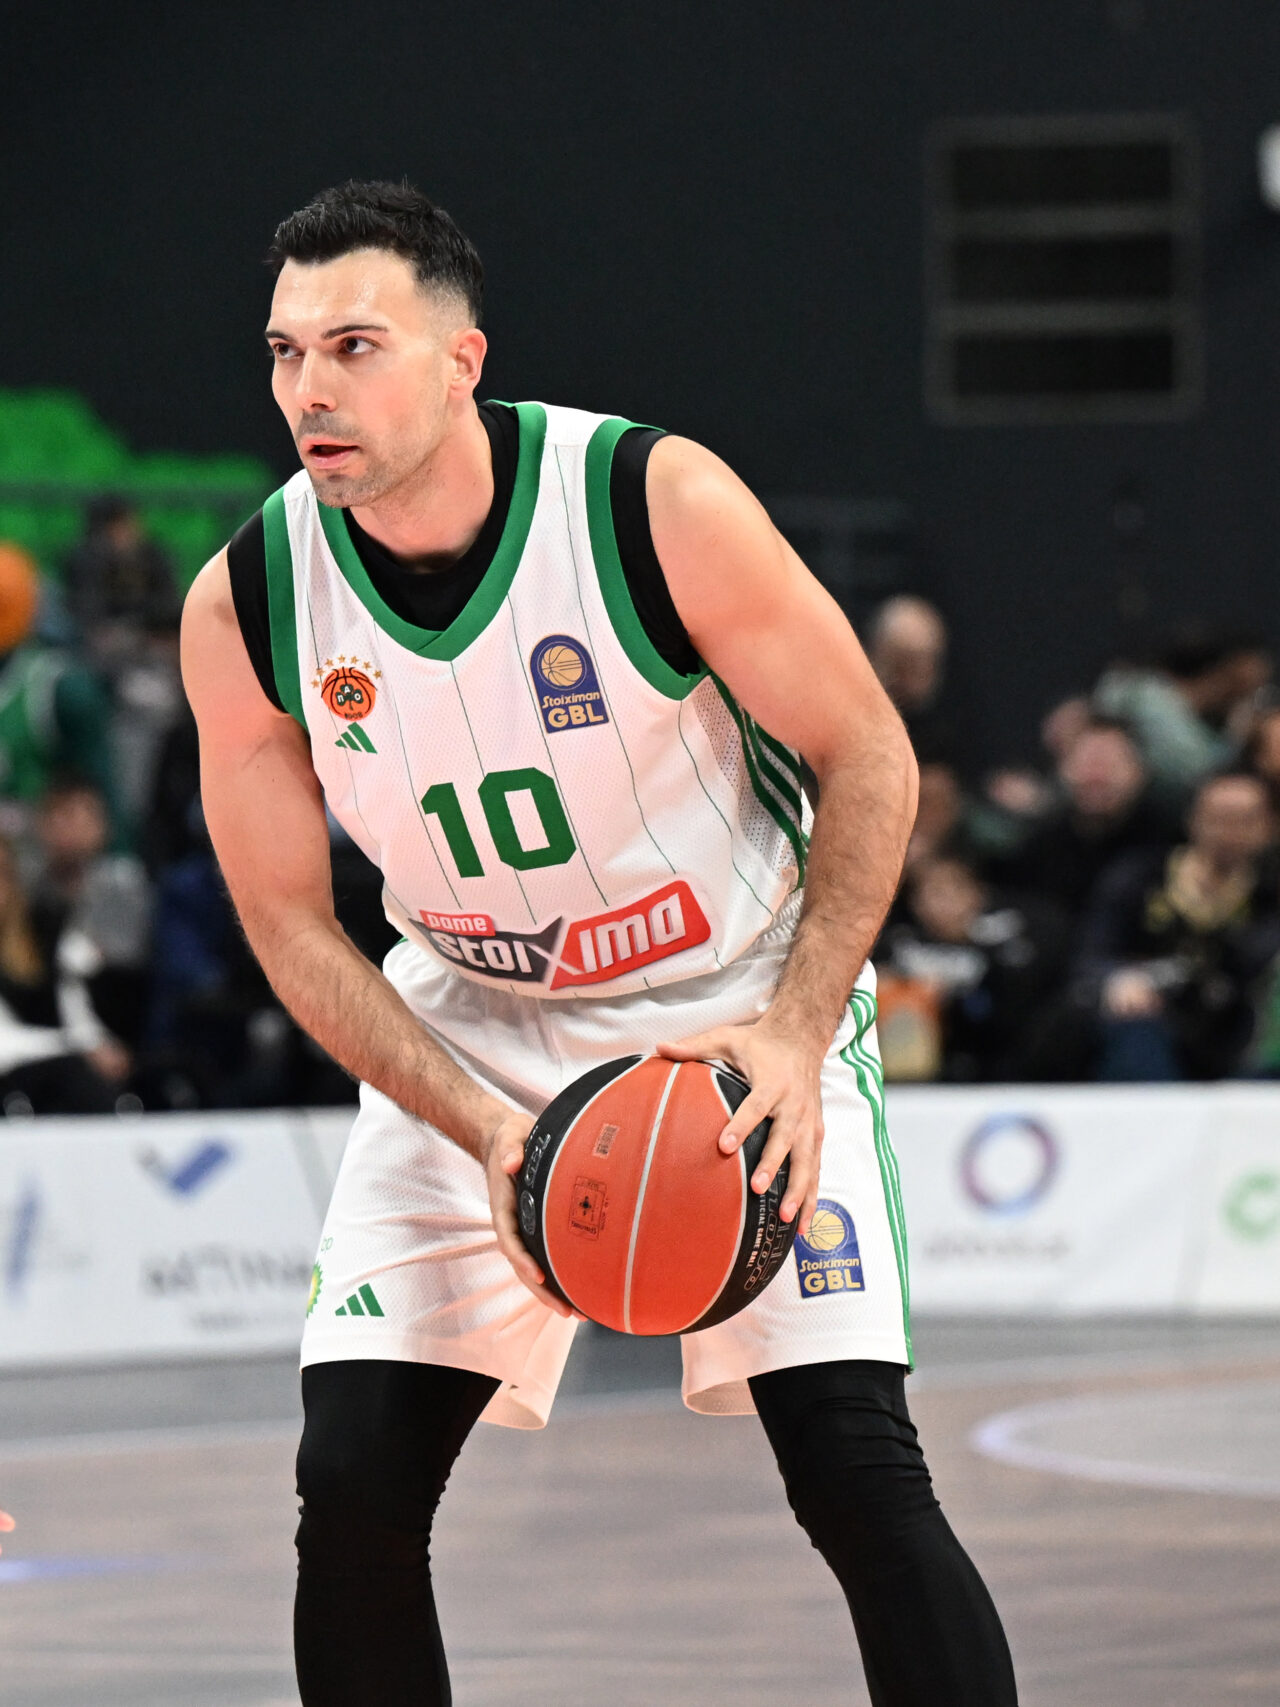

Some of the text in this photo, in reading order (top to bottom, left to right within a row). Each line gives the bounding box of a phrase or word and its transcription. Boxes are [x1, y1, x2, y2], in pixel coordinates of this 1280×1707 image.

[542, 692, 601, 709] Stoiximan
[547, 703, 604, 728] GBL
[420, 767, 577, 878] 10
[799, 1258, 860, 1273] Stoiximan
[804, 1268, 861, 1293] GBL
